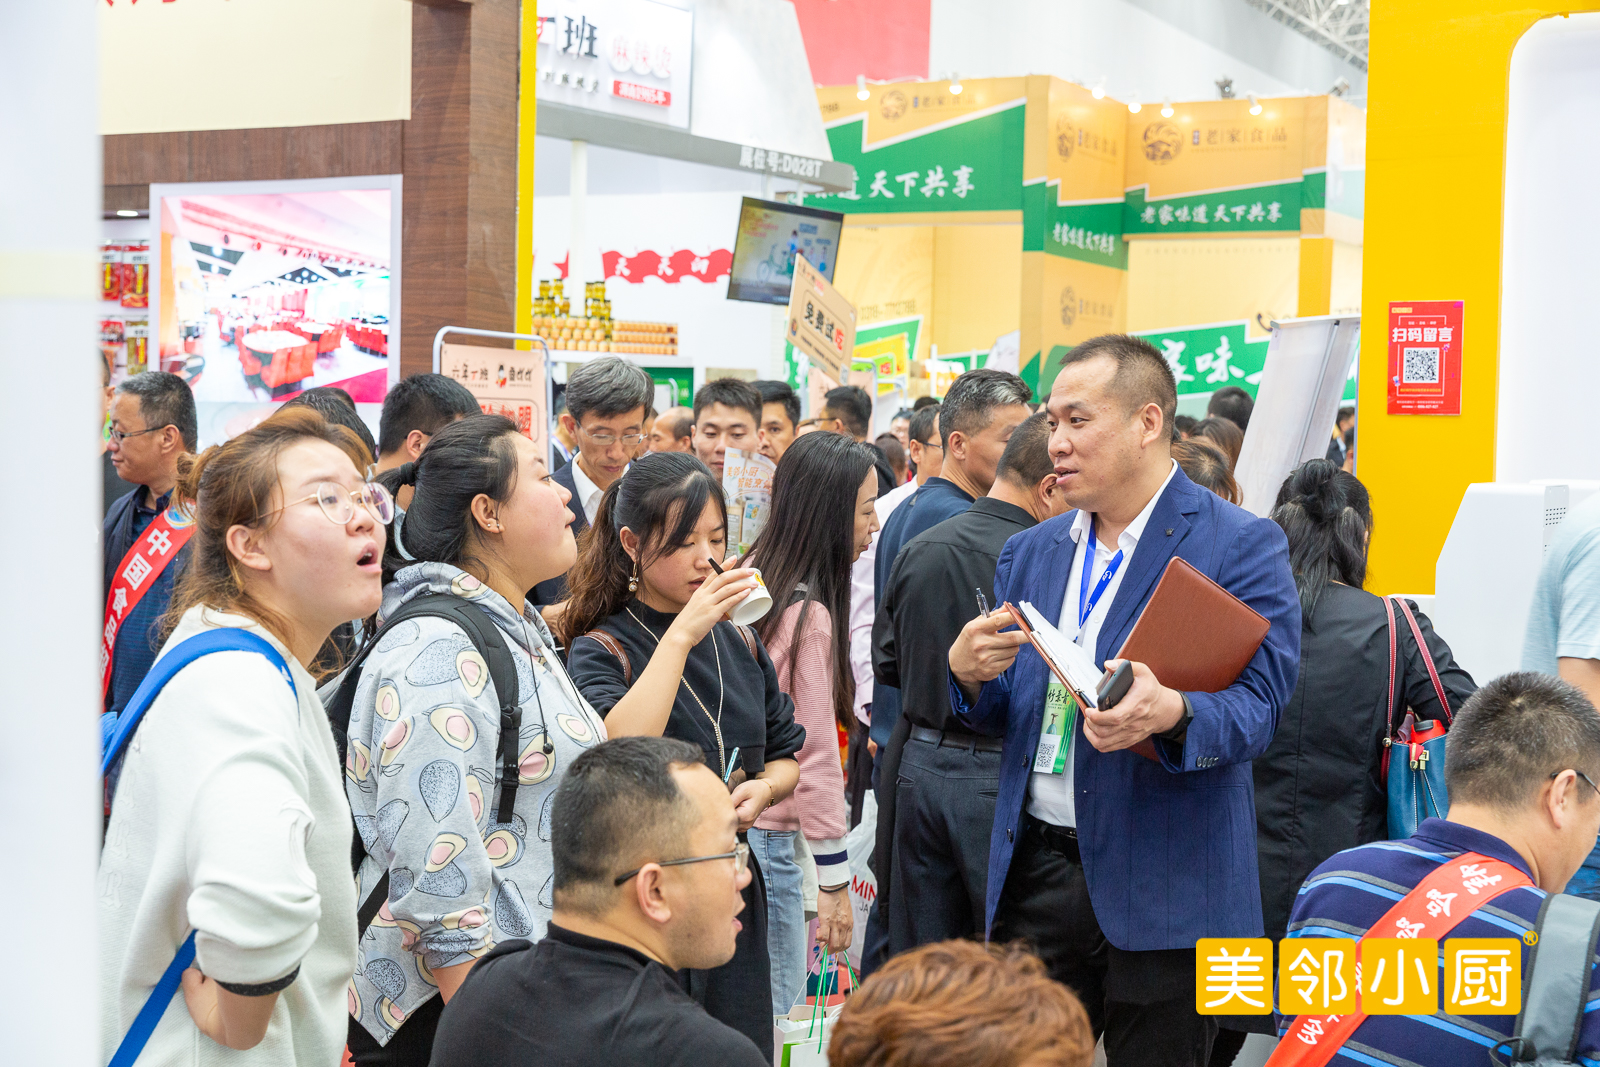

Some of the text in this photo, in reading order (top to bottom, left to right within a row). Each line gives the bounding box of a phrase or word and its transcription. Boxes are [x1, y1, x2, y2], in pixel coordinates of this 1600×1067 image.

[739, 146, 823, 178] 展位号:D028T
[868, 165, 975, 199] 天下共享
[1140, 201, 1283, 225] 老家味道 天下共享
[1392, 327, 1453, 342] 扫码留言
[726, 466, 759, 478] 美邻小厨
